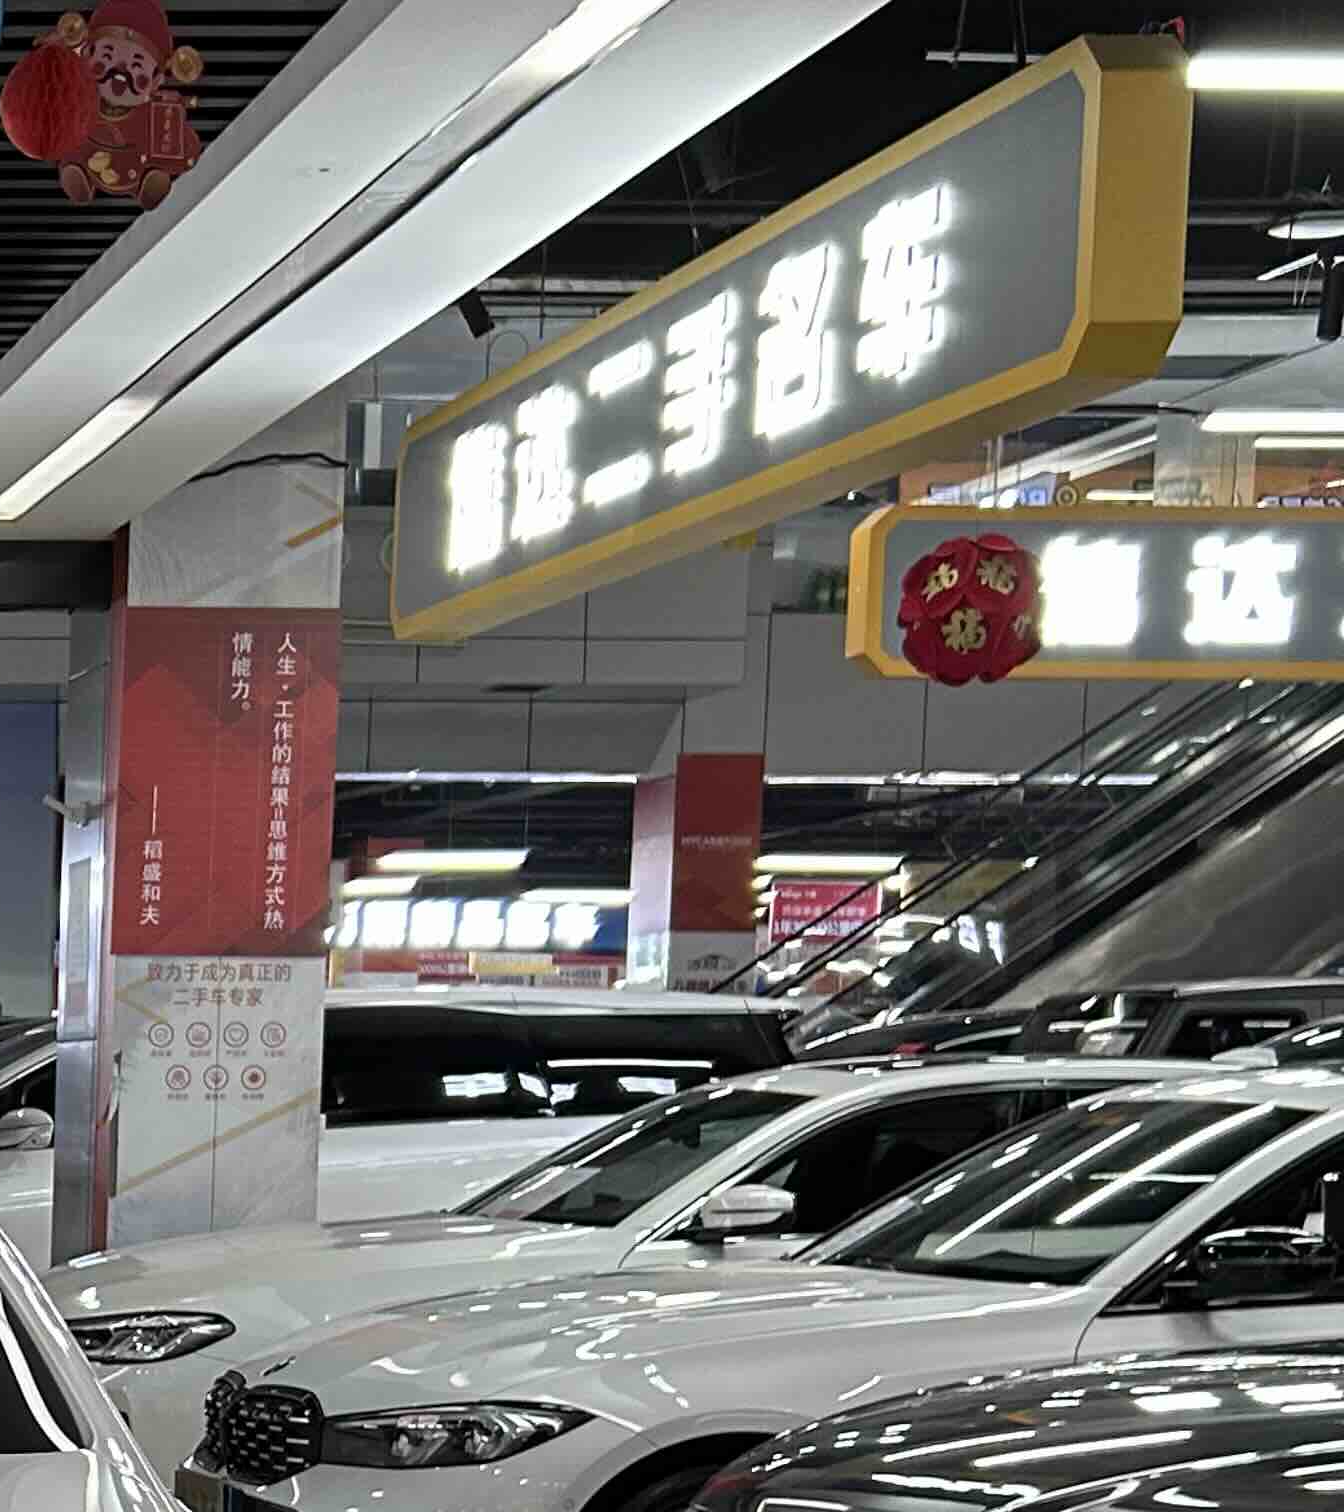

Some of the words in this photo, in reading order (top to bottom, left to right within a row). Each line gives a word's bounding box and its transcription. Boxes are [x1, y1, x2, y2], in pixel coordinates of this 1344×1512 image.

[173, 987, 265, 1007] 二手车专家
